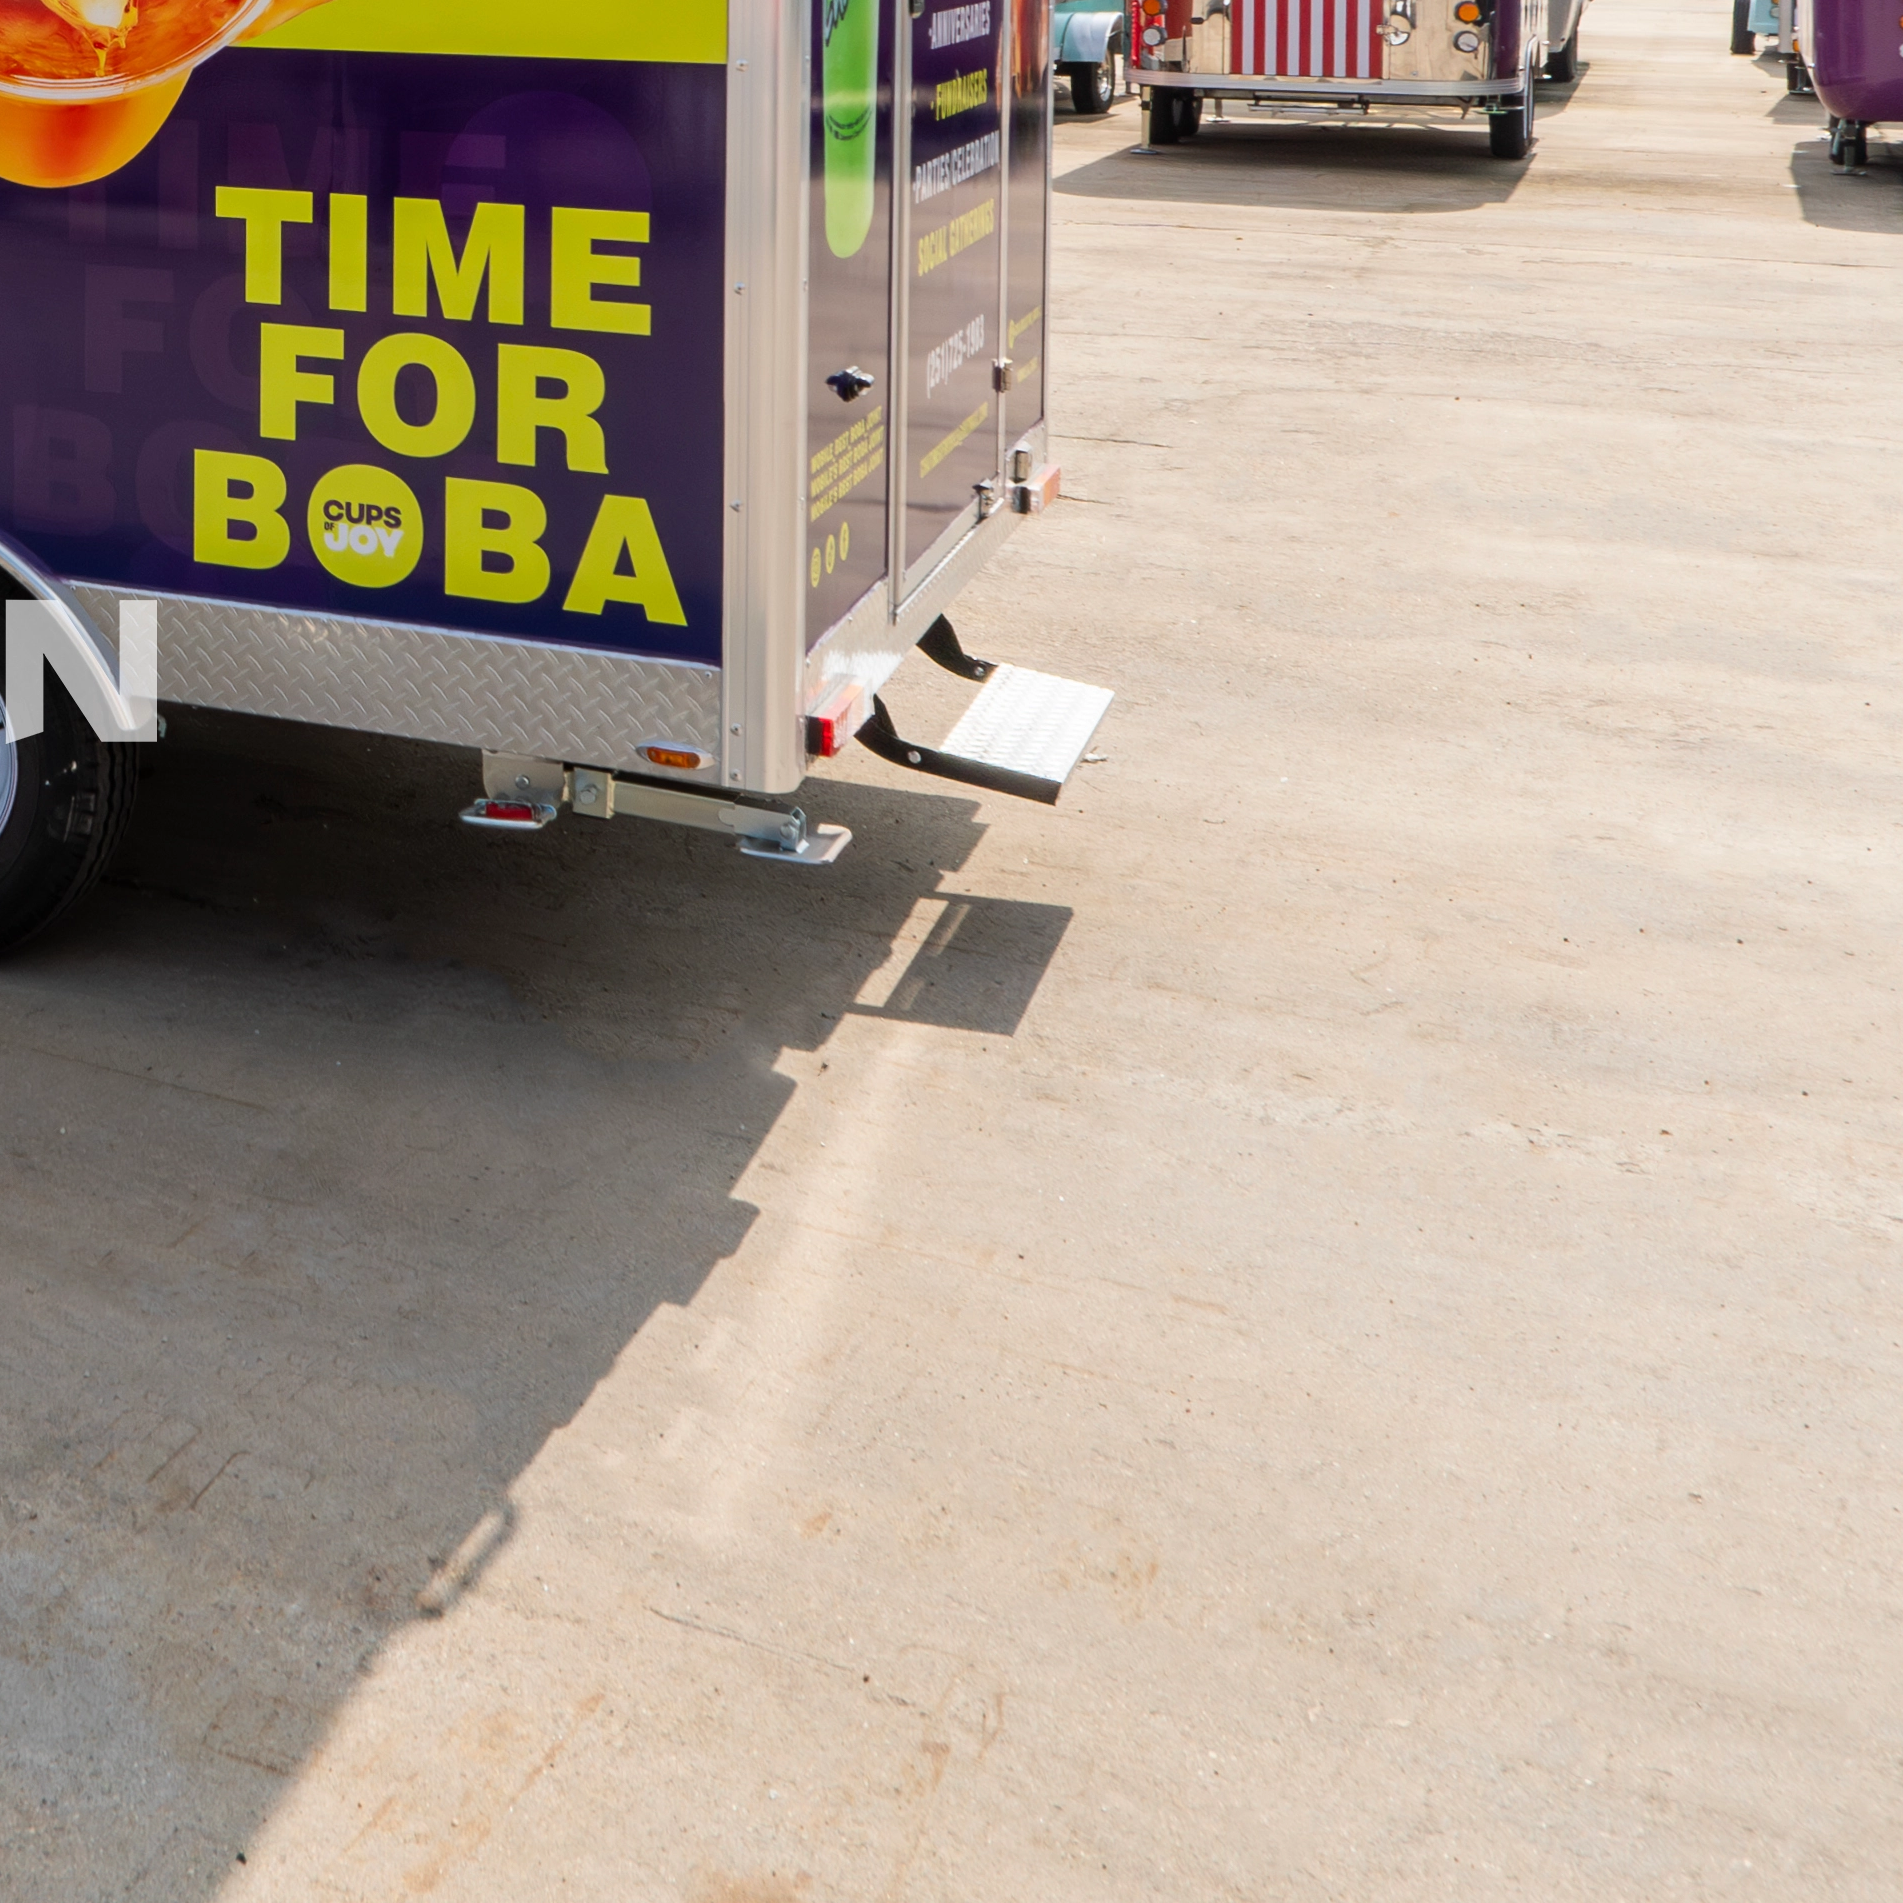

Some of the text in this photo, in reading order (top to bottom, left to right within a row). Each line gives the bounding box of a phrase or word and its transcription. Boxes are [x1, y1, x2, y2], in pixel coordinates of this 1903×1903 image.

[931, 0, 991, 50] ANNIVERSARIES
[935, 68, 988, 121] FUNDRAISERS
[215, 186, 652, 336] TIME
[260, 322, 609, 475] FOR
[193, 449, 688, 627] BOBA
[323, 499, 402, 529] CUPS
[323, 523, 404, 558] JOY
